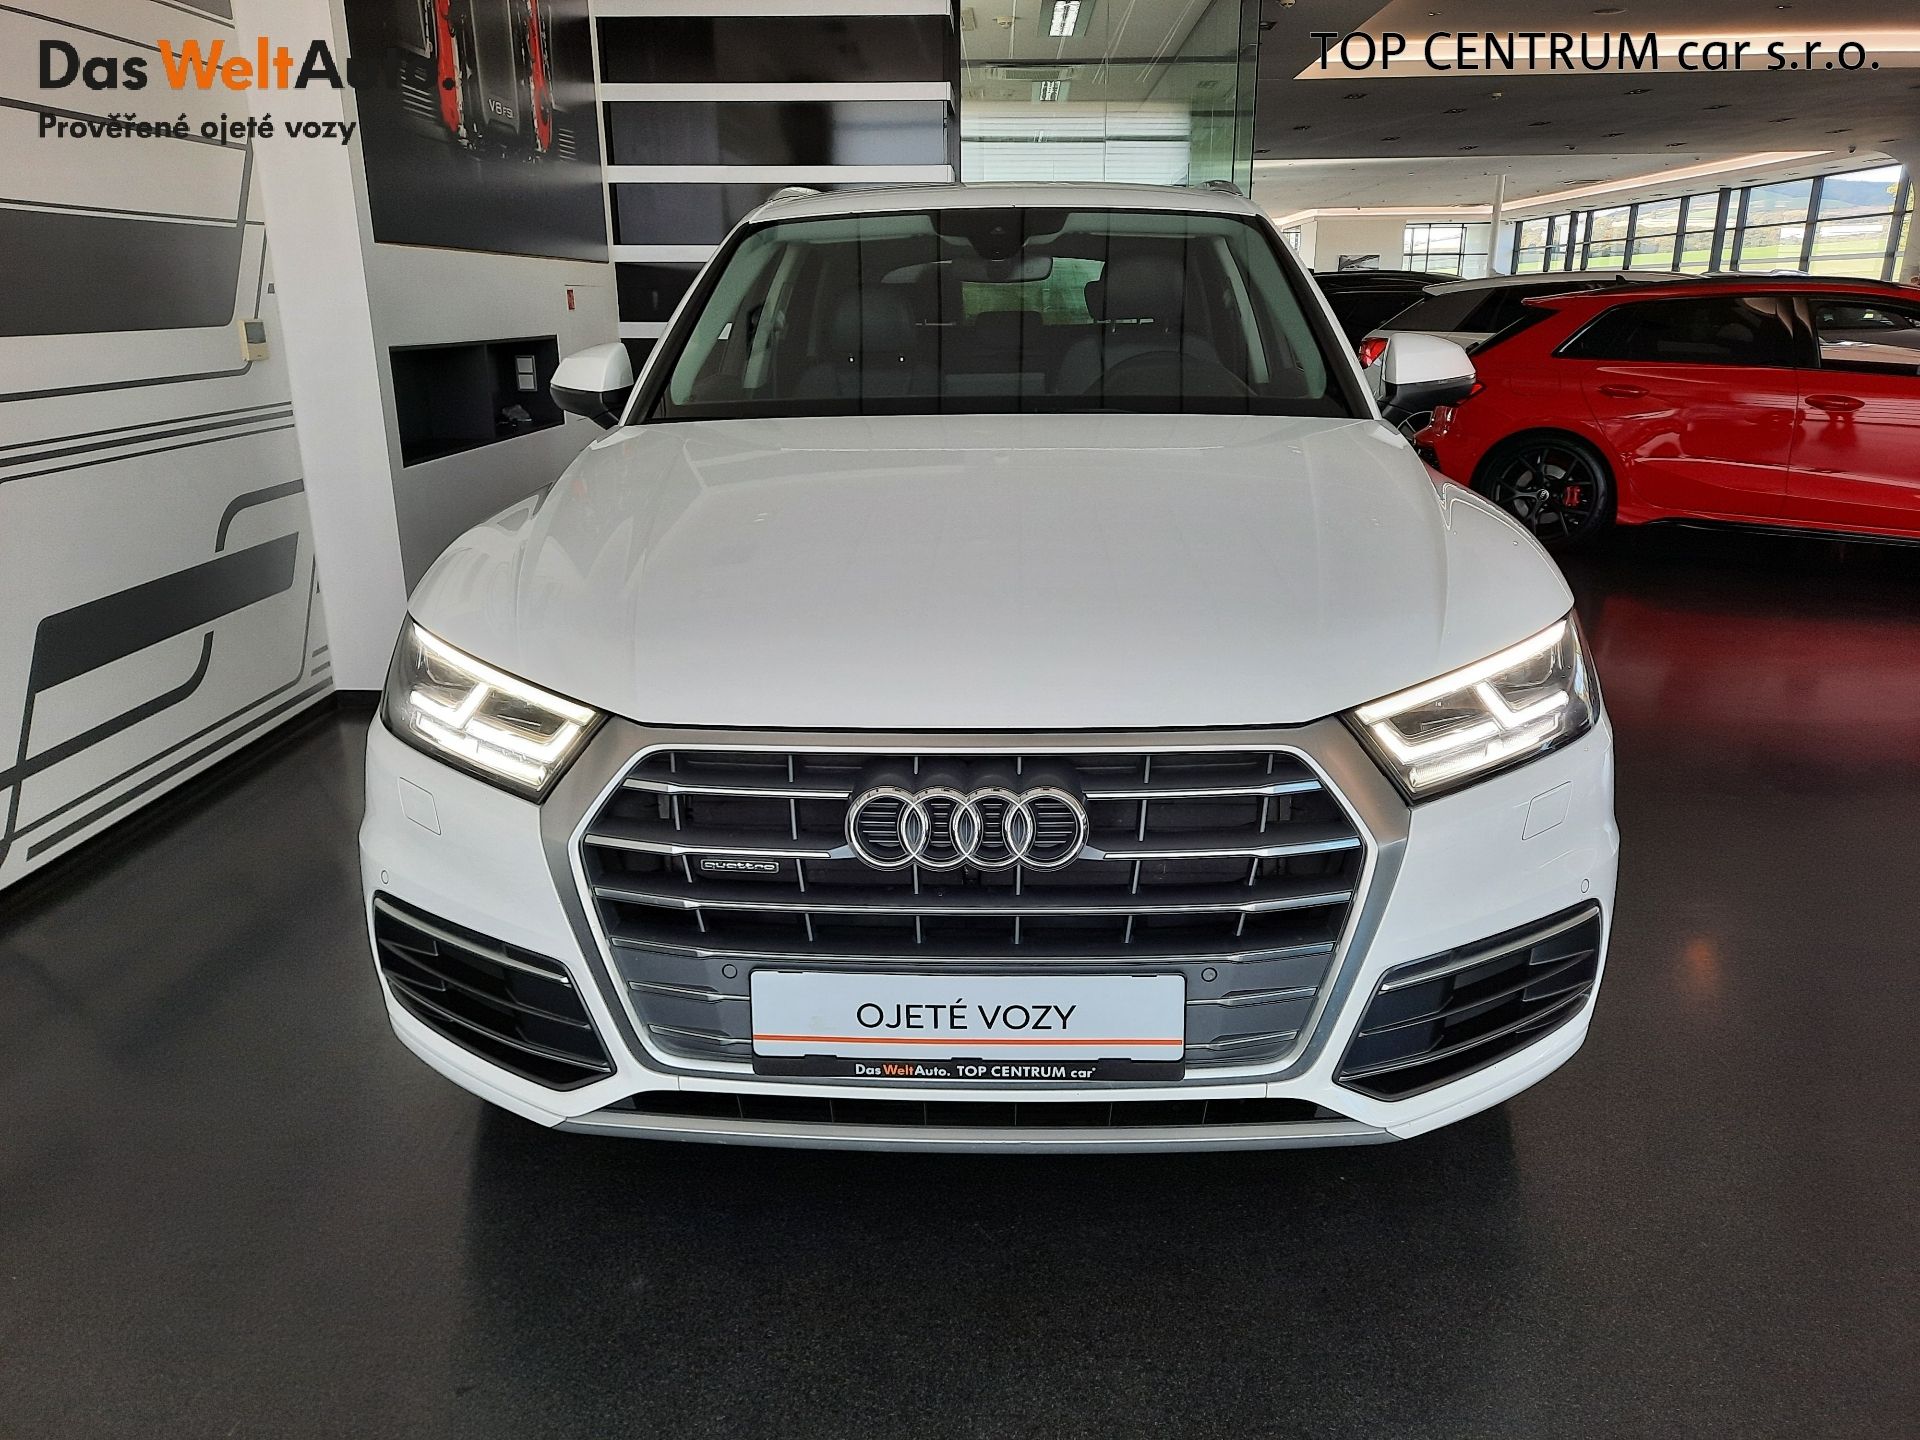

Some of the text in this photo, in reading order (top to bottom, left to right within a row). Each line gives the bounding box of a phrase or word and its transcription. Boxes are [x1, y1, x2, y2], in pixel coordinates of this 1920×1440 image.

[488, 98, 503, 115] V8
[704, 861, 776, 871] quattro
[856, 998, 1077, 1030] OJETÉ VOZY
[855, 1063, 882, 1076] Das
[956, 1065, 987, 1078] TOP
[990, 1065, 1066, 1078] CENTRUM
